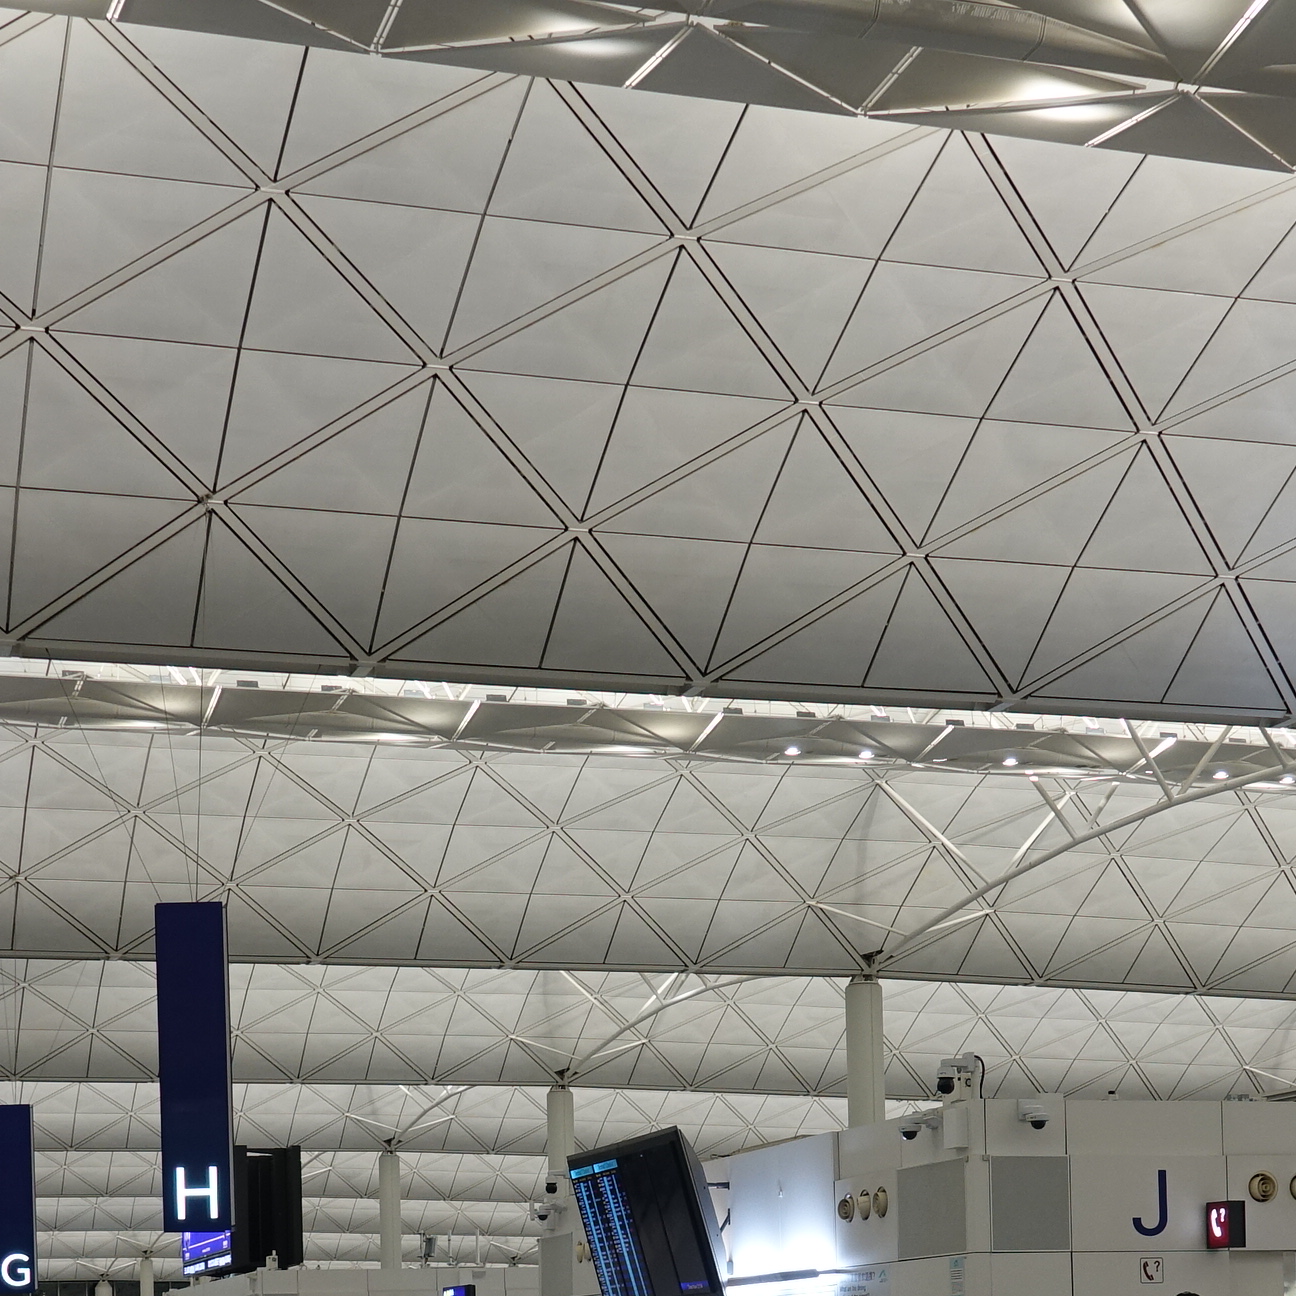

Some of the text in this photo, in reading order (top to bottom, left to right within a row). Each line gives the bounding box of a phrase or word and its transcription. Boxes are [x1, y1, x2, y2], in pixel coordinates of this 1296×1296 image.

[175, 1165, 219, 1220] H
[1132, 1169, 1168, 1237] J
[0, 1253, 31, 1287] G
